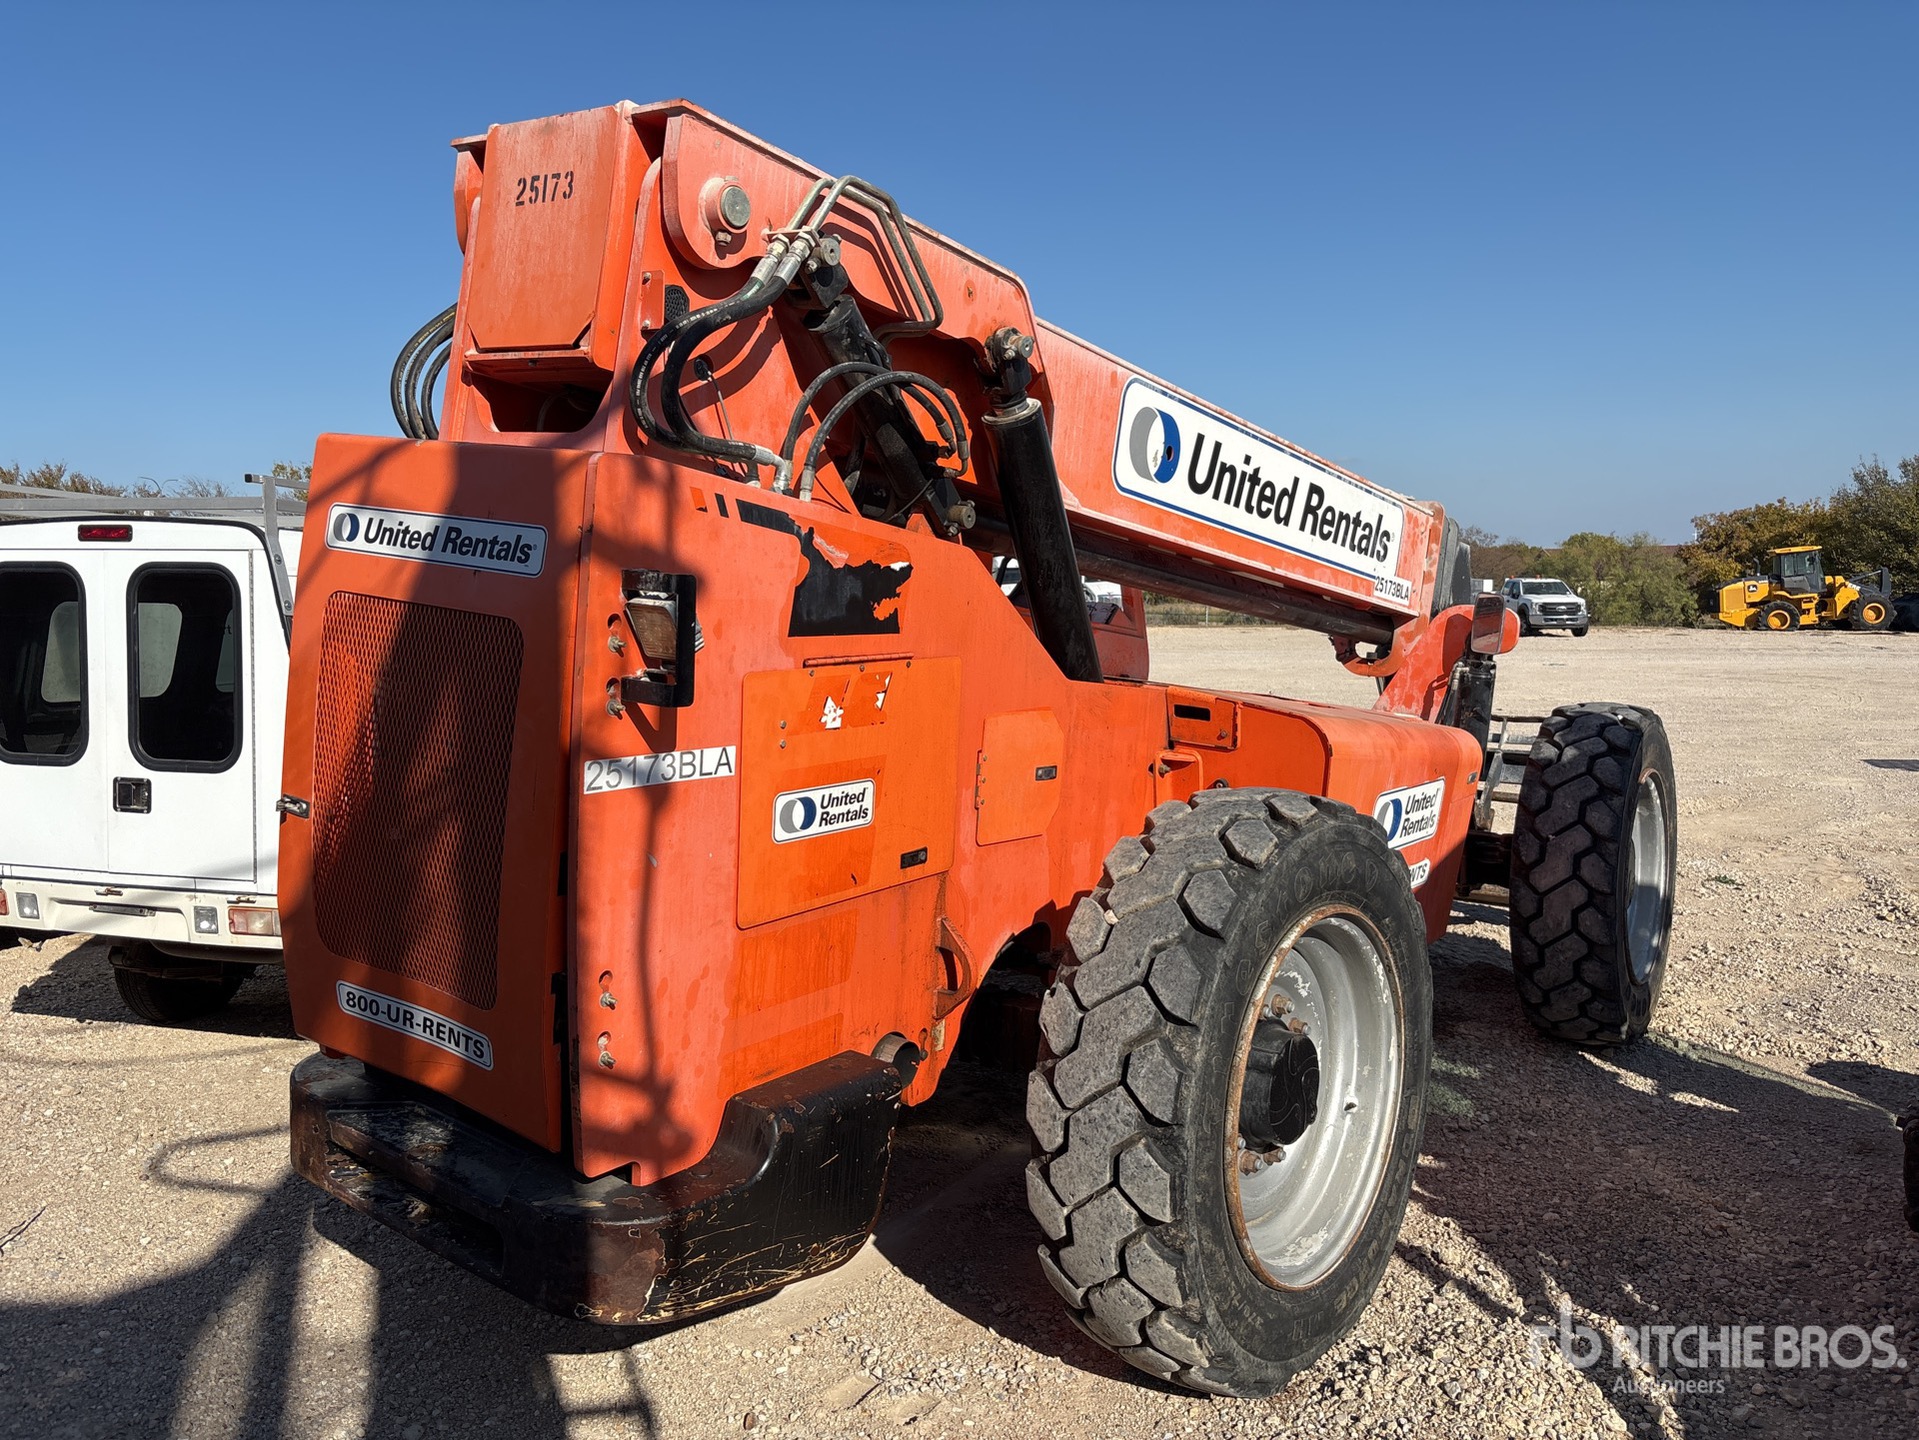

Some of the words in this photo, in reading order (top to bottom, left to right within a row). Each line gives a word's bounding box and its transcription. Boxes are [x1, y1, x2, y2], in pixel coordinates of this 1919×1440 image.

[515, 170, 575, 207] 25173
[1187, 432, 1300, 528] United
[1299, 482, 1392, 563] Rentals
[363, 517, 440, 552] United
[441, 526, 533, 564] Rentals
[1374, 576, 1410, 601] 25173BLA
[585, 747, 734, 792] 25173BLA
[819, 787, 867, 811] United
[1404, 787, 1441, 816] United
[818, 804, 869, 828] Rentals
[1399, 810, 1437, 839] Rentals
[346, 990, 486, 1060] 800-UR-RENTS
